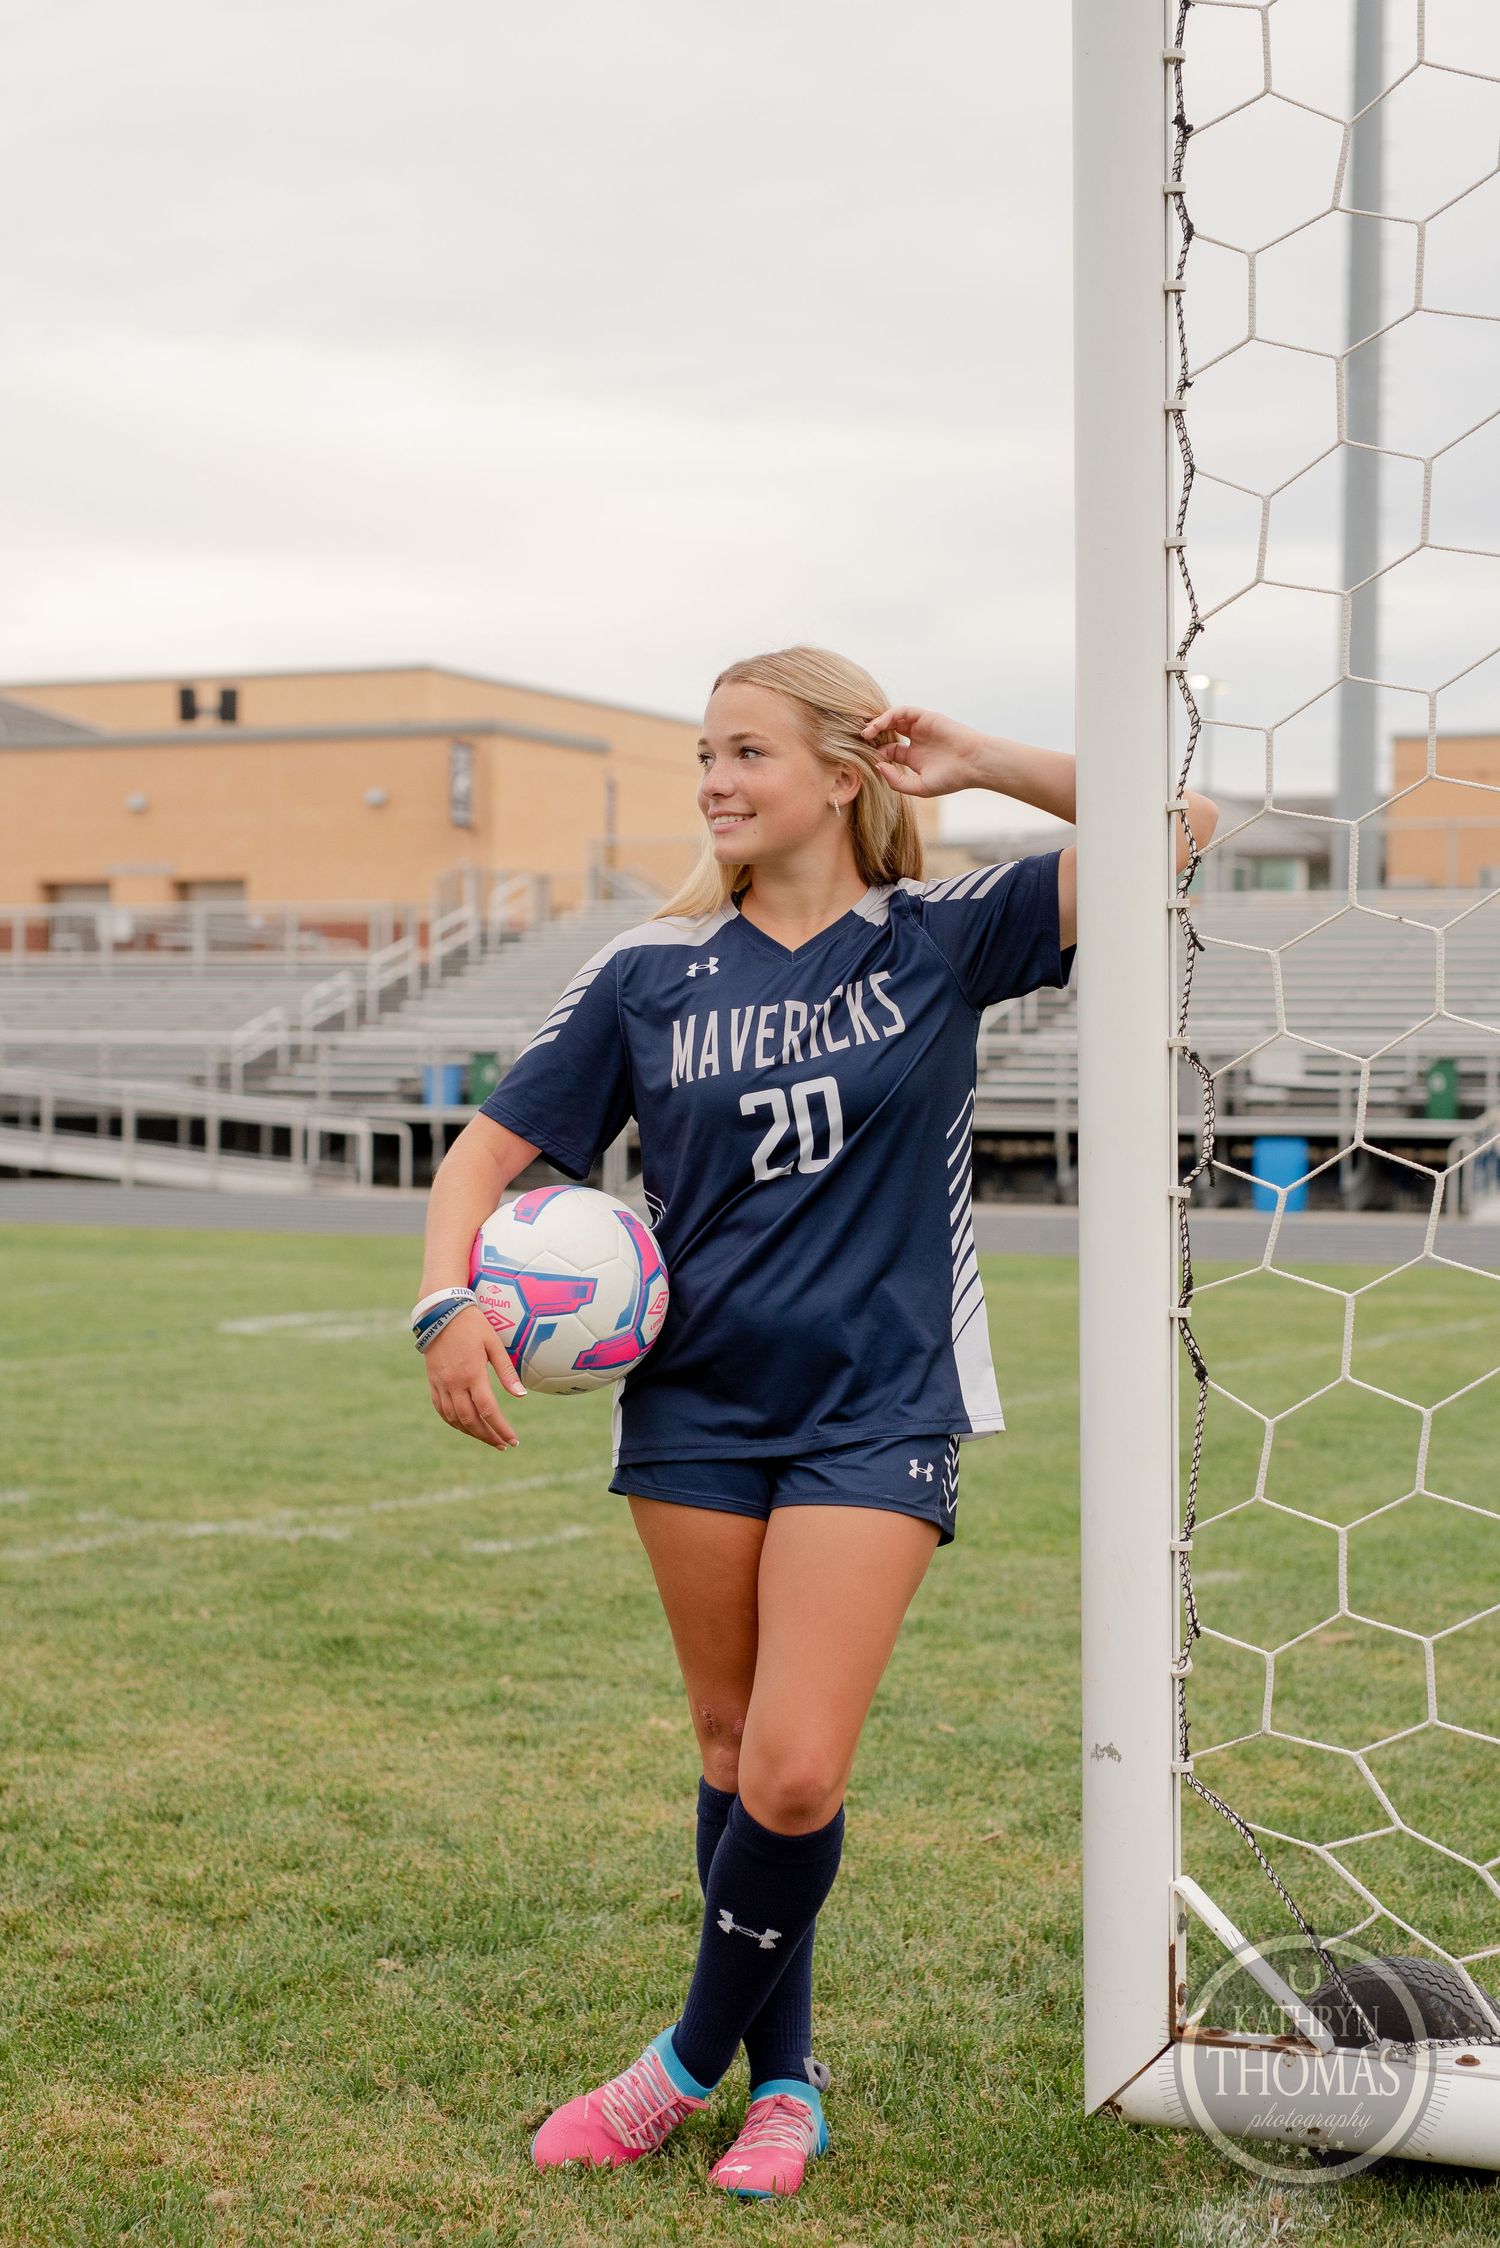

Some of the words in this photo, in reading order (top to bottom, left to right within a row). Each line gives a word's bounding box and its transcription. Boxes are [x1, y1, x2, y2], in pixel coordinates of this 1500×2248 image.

[671, 970, 906, 1089] MAVERICKS
[739, 1076, 843, 1182] 20
[450, 1289, 474, 1298] AMILY
[479, 1295, 511, 1309] umbro
